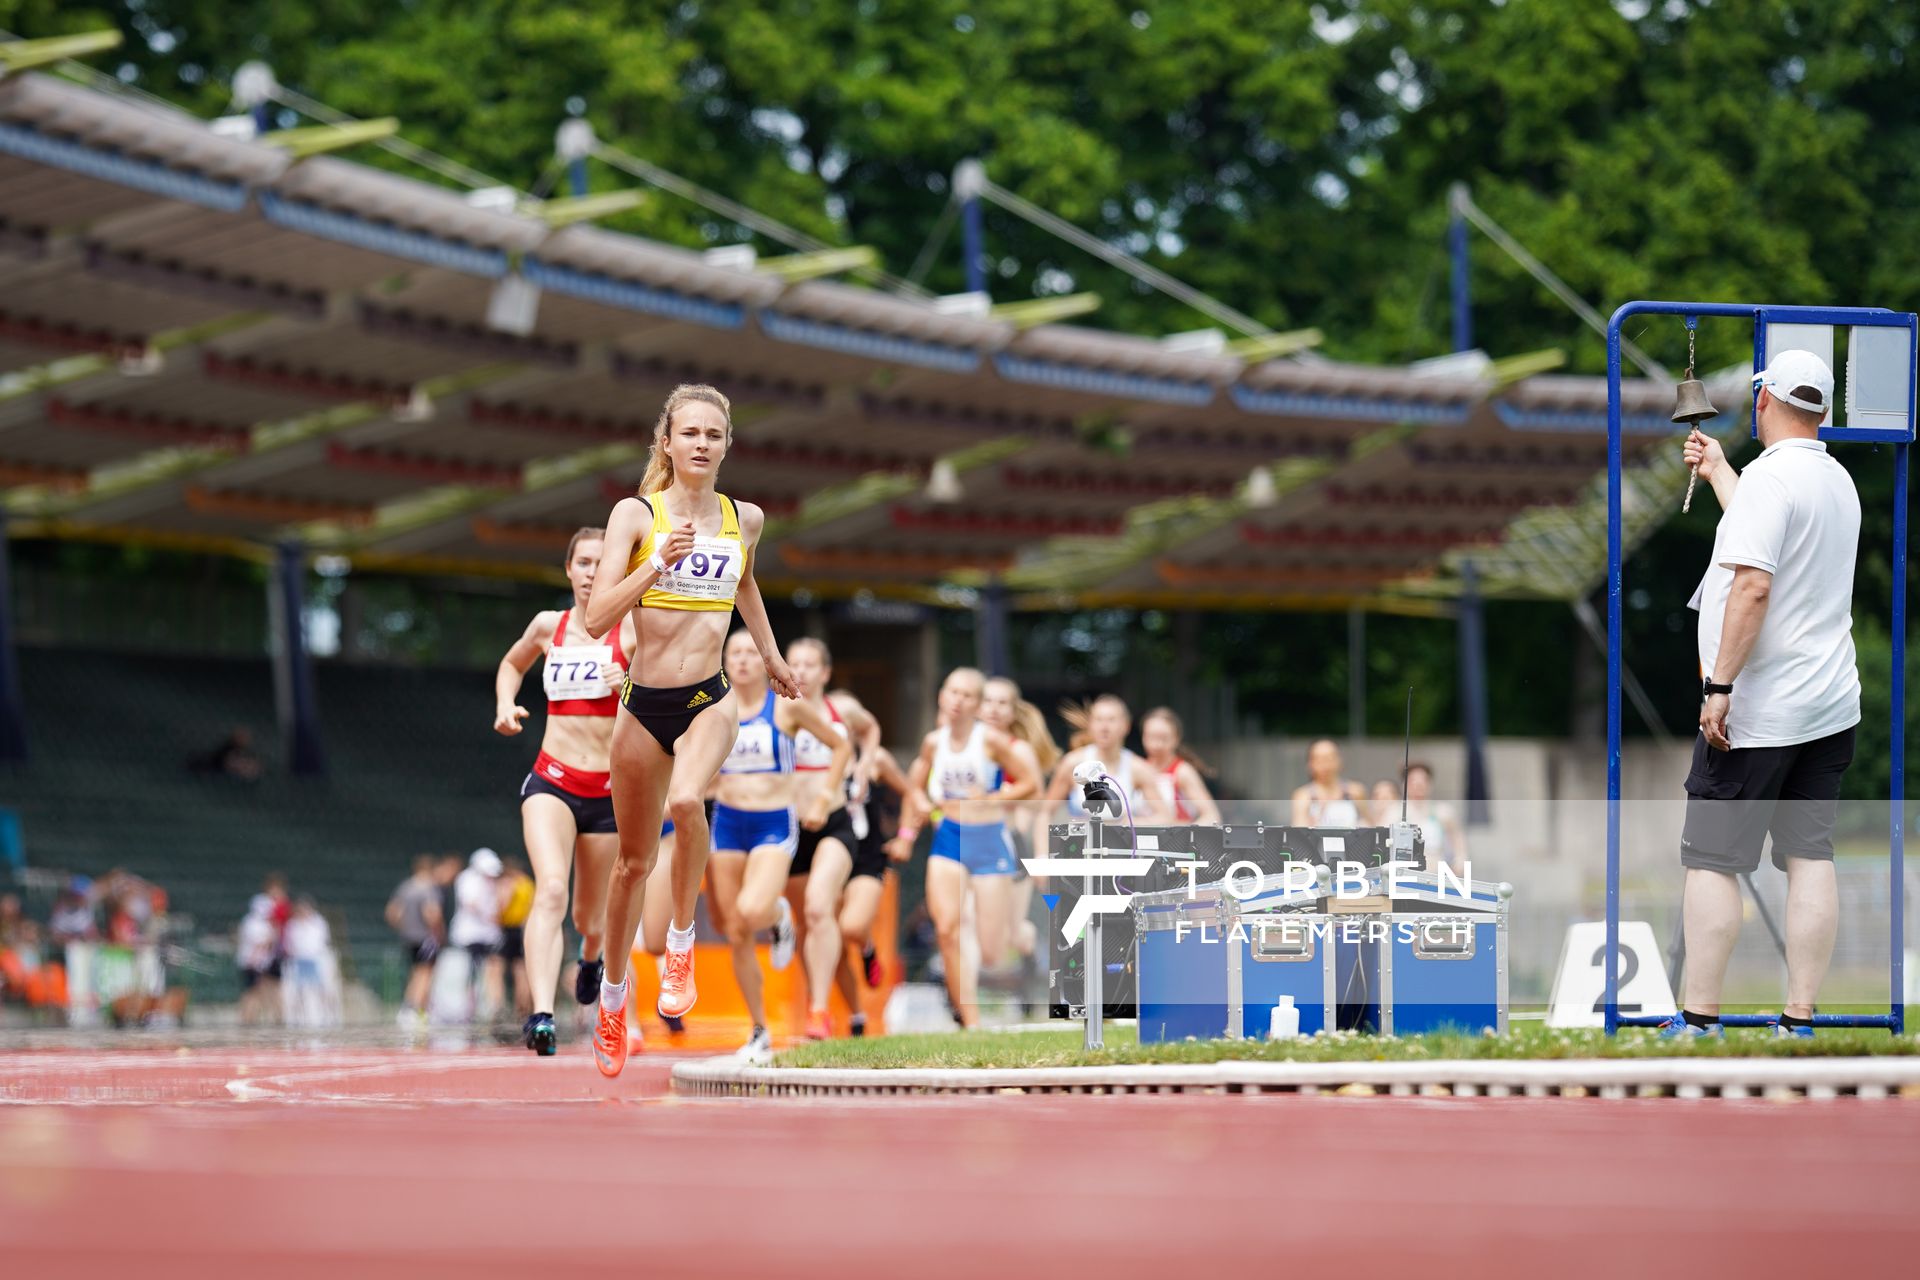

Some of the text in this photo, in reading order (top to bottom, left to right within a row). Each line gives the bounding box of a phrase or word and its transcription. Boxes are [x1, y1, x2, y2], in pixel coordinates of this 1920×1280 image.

[706, 583, 720, 591] 2021
[550, 661, 598, 682] 772
[687, 696, 713, 709] adidas
[1591, 943, 1642, 1012] 2
